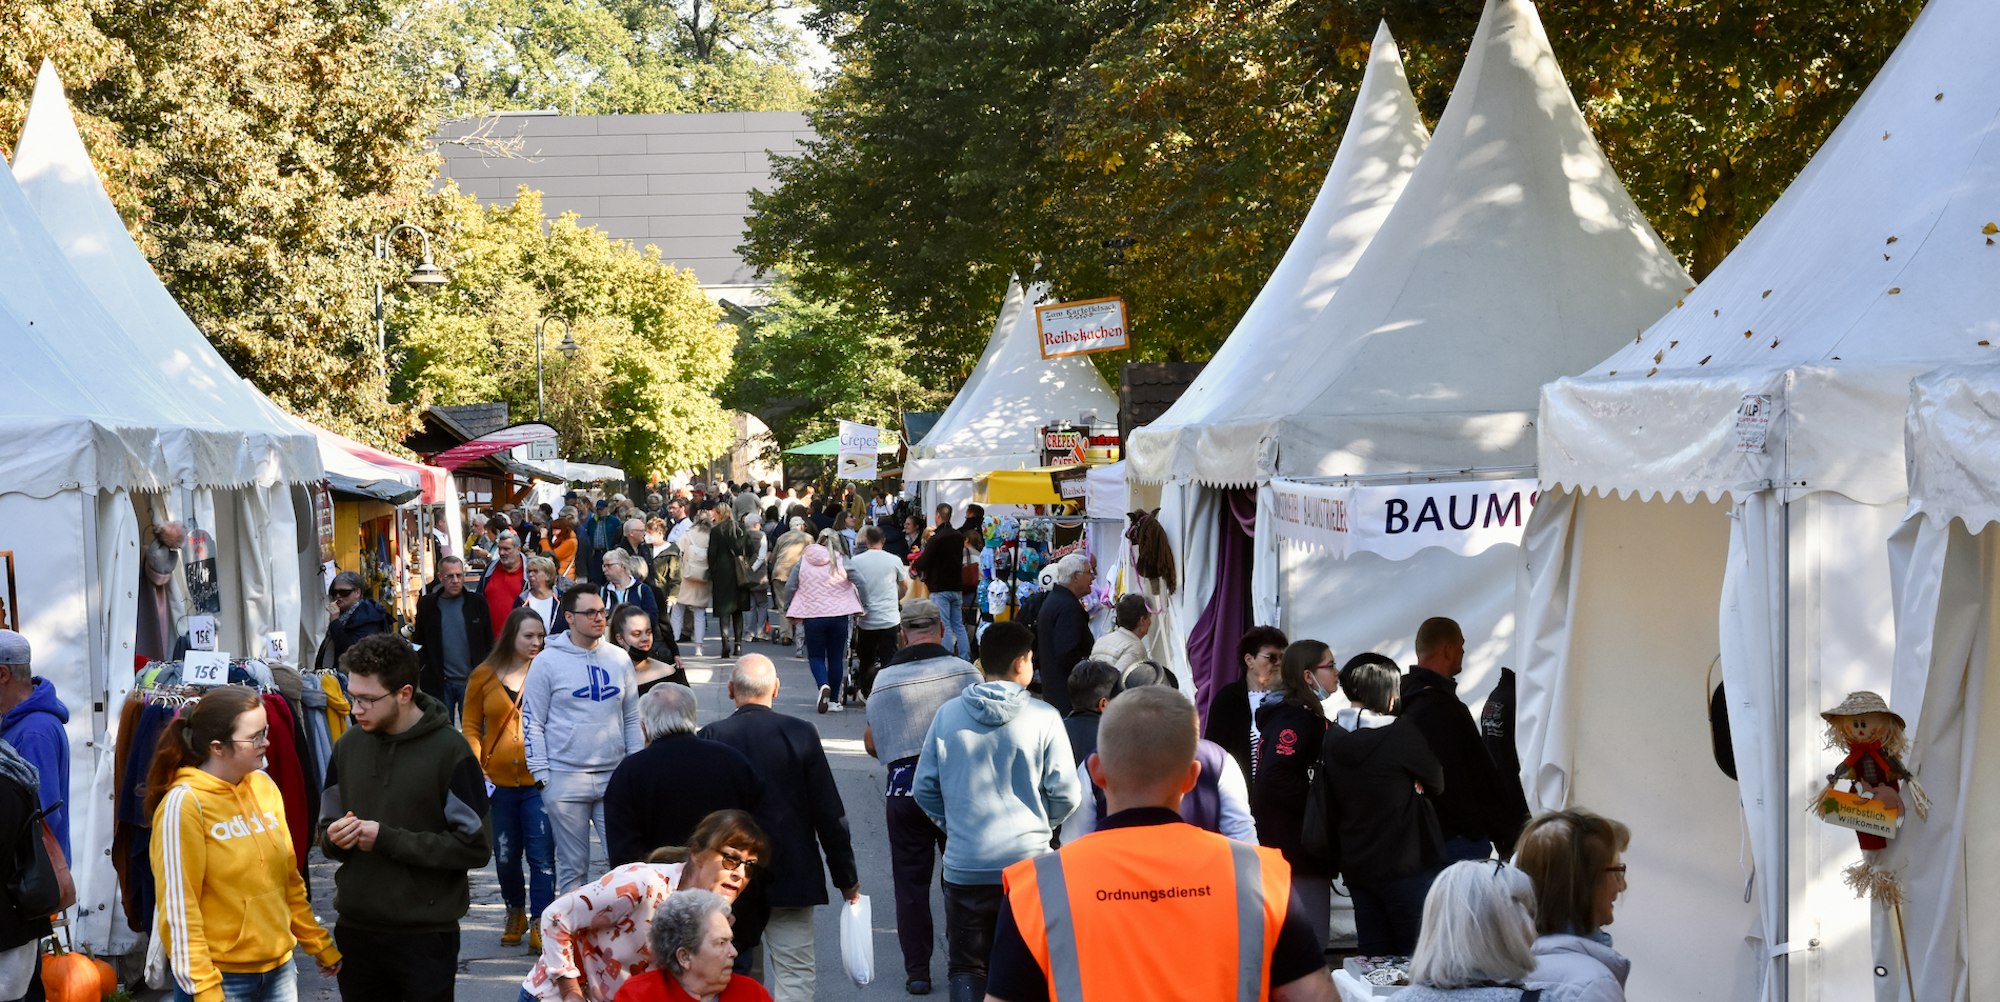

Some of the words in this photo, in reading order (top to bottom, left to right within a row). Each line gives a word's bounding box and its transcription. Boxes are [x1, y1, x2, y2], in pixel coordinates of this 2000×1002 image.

[1045, 311, 1063, 319] Zum
[1044, 325, 1123, 345] Reibekuchen
[195, 630, 210, 644] 15€
[271, 639, 283, 651] 15€
[194, 665, 219, 680] 15€
[1840, 803, 1886, 821] Herbstlich
[1096, 885, 1211, 902] Ordnungsdienst
